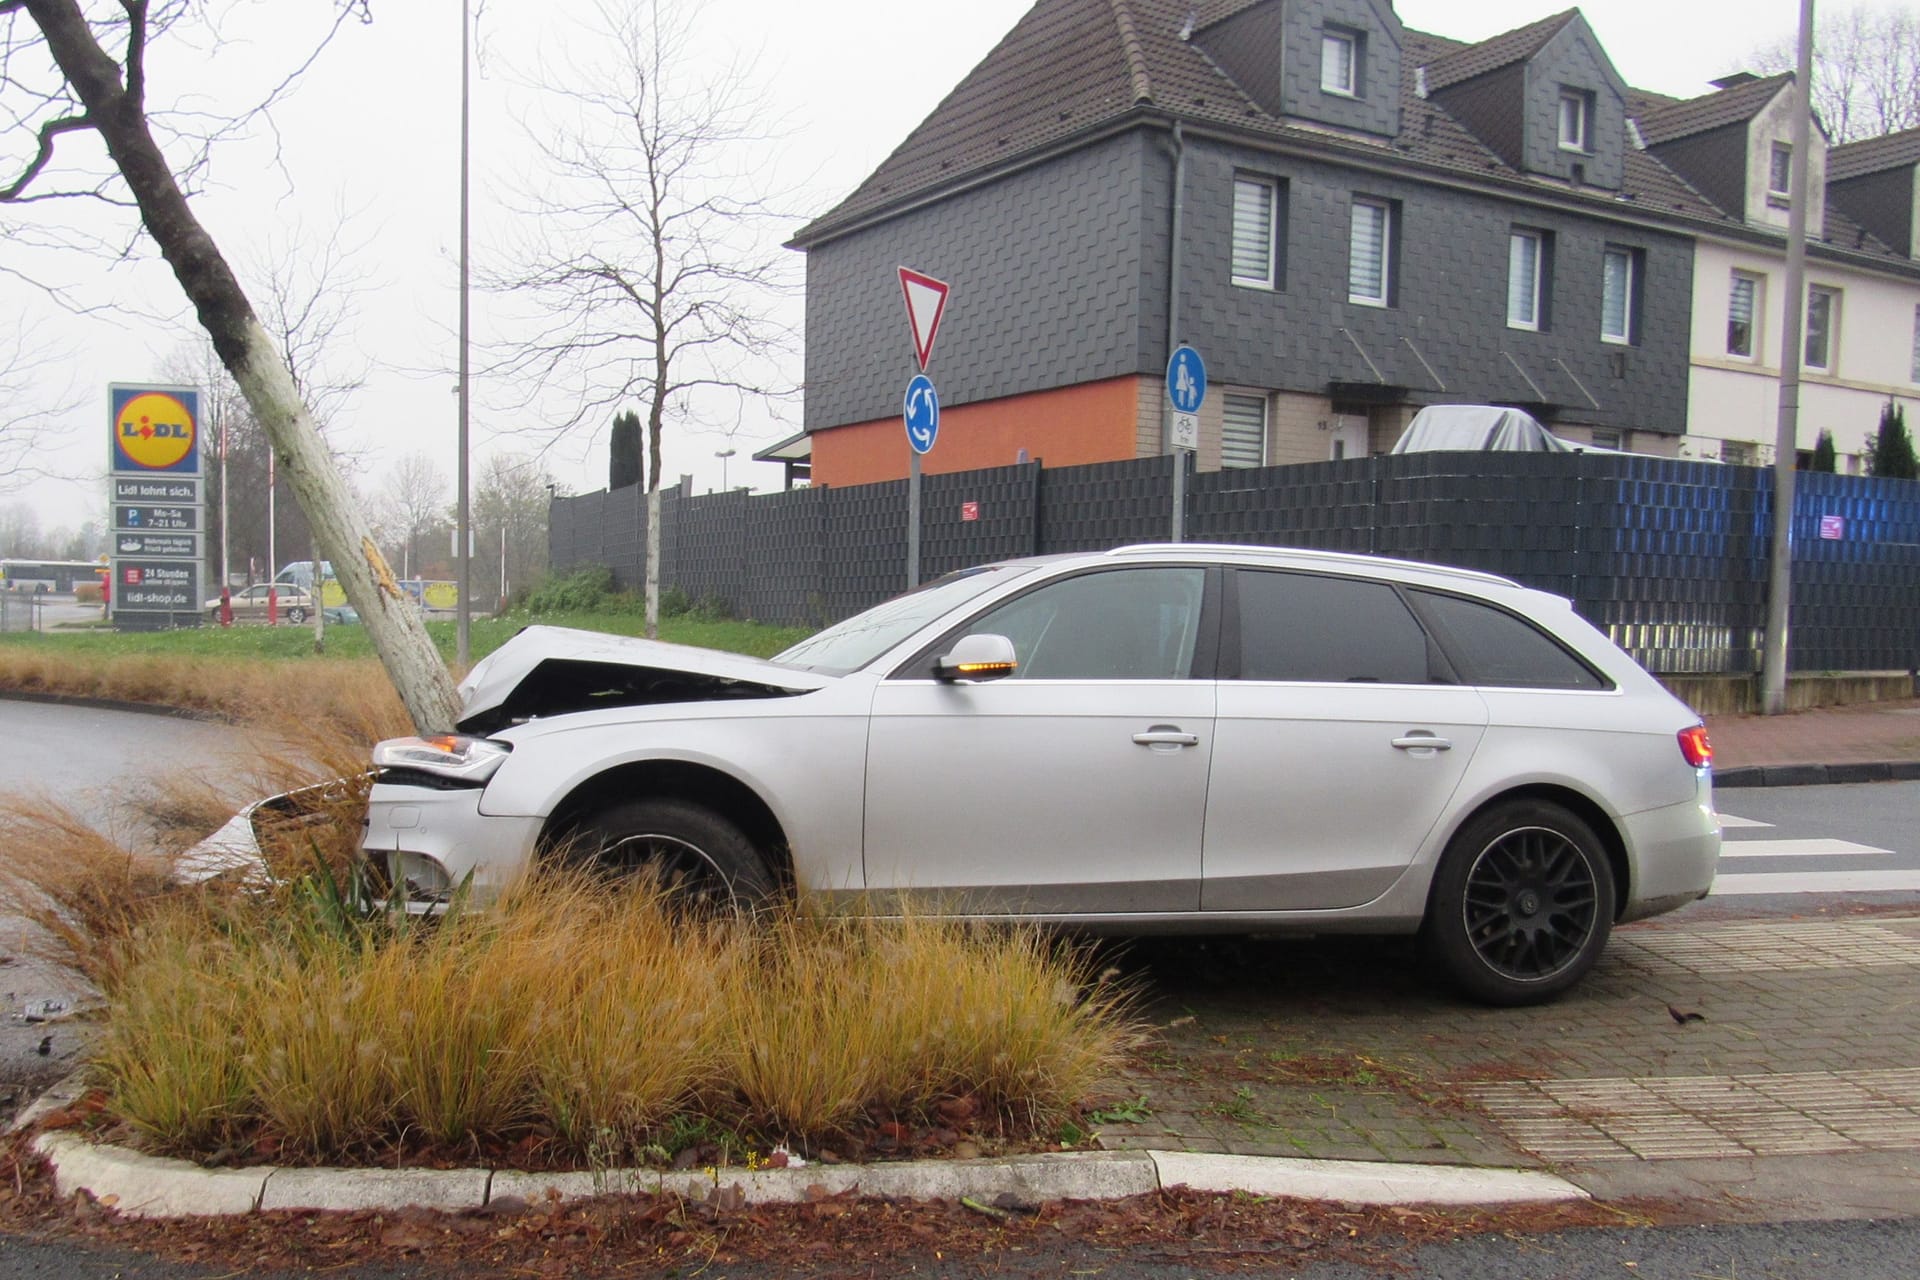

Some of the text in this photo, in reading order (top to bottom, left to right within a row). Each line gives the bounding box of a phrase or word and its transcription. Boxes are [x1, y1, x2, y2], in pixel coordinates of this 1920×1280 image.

[118, 485, 194, 498] Lidl lohnt sich.
[171, 519, 188, 529] Uhr
[144, 568, 156, 578] 24
[156, 568, 189, 579] Stunden
